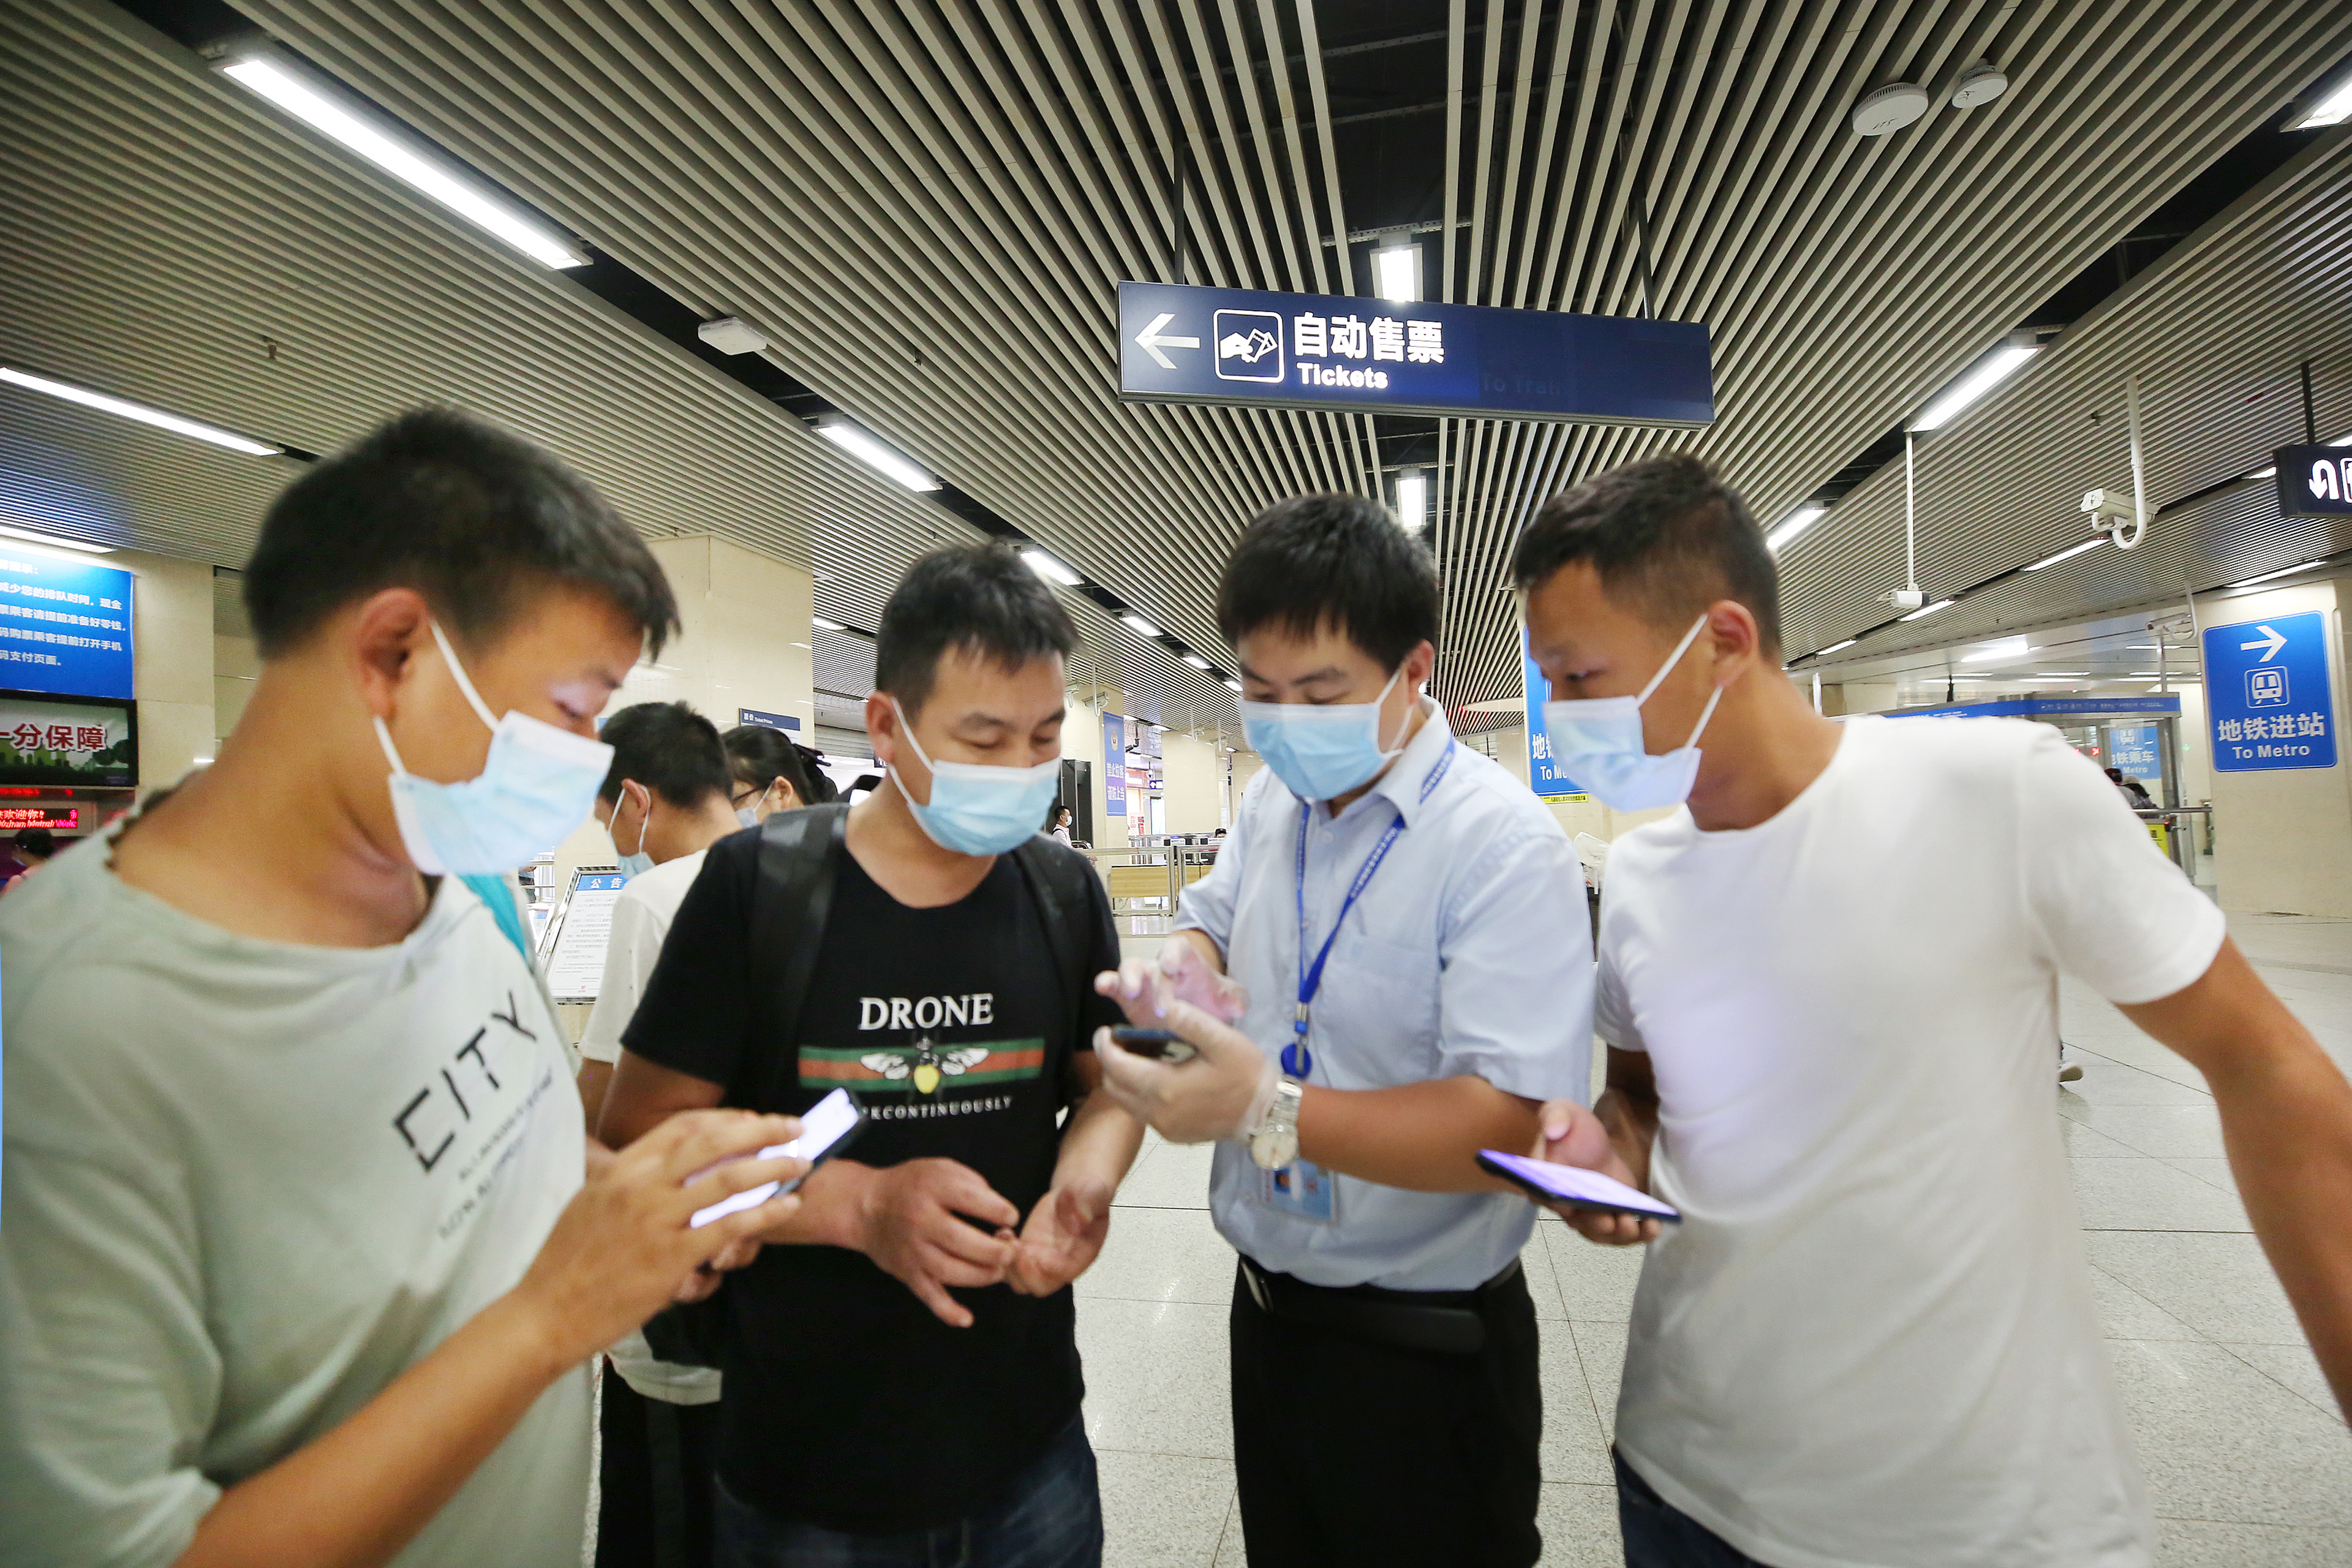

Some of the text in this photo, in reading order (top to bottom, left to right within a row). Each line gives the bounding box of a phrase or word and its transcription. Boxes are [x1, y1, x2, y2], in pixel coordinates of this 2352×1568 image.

[1294, 311, 1445, 364] 自动售票
[1297, 362, 1389, 389] Tickets
[2218, 711, 2325, 742] 地铁进站
[2232, 744, 2311, 760] To Metro
[1540, 766, 1553, 780] To
[859, 993, 993, 1031] DRONE
[392, 989, 538, 1175] CITY
